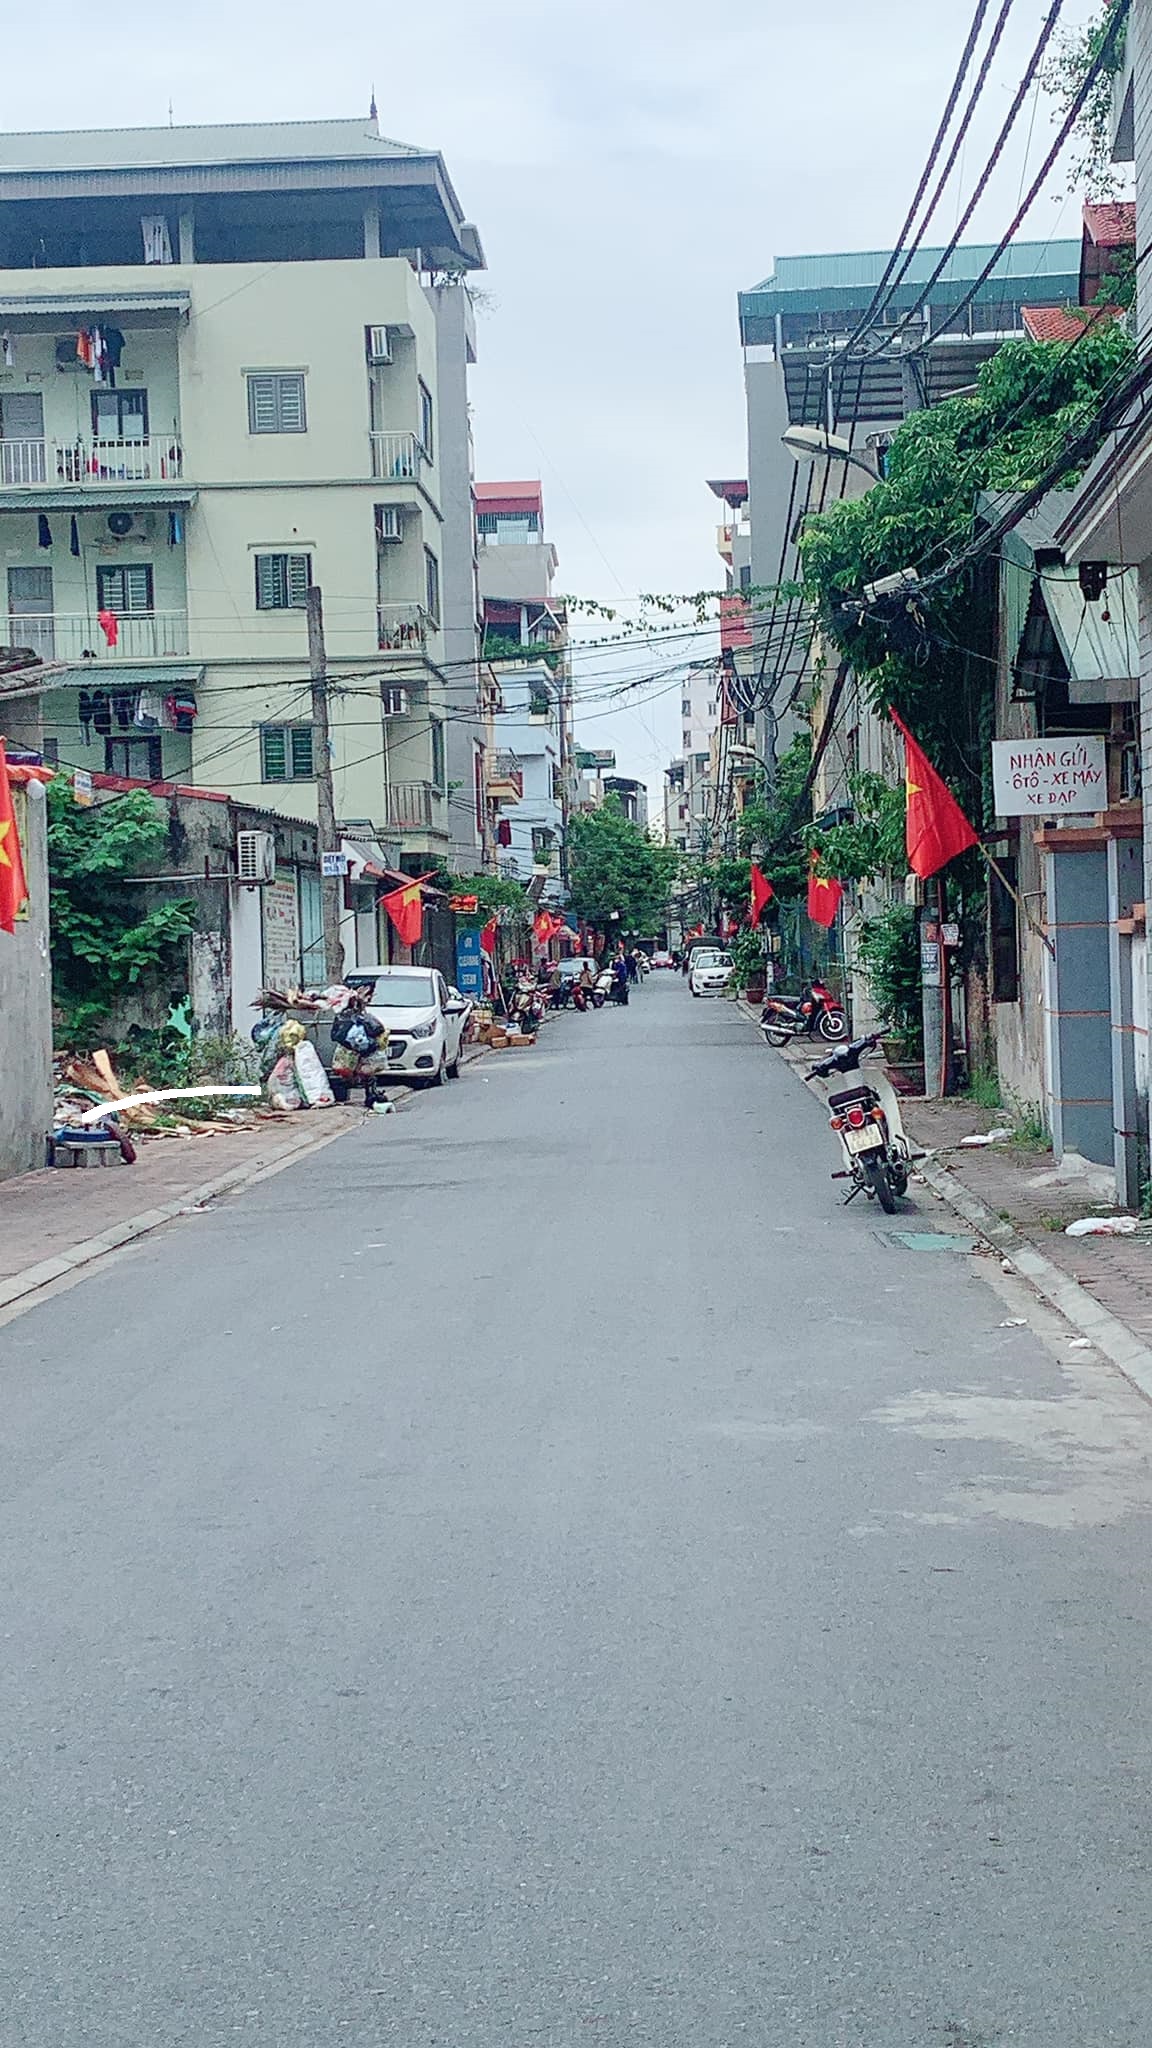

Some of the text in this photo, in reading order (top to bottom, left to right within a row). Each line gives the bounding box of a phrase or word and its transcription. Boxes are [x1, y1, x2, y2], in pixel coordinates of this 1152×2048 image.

[1010, 747, 1056, 770] NHẬN
[1013, 771, 1039, 789] ÔTÔ
[1051, 771, 1069, 786] XE
[1073, 763, 1102, 787] MÁY
[1026, 790, 1077, 807] XE ĐẠP
